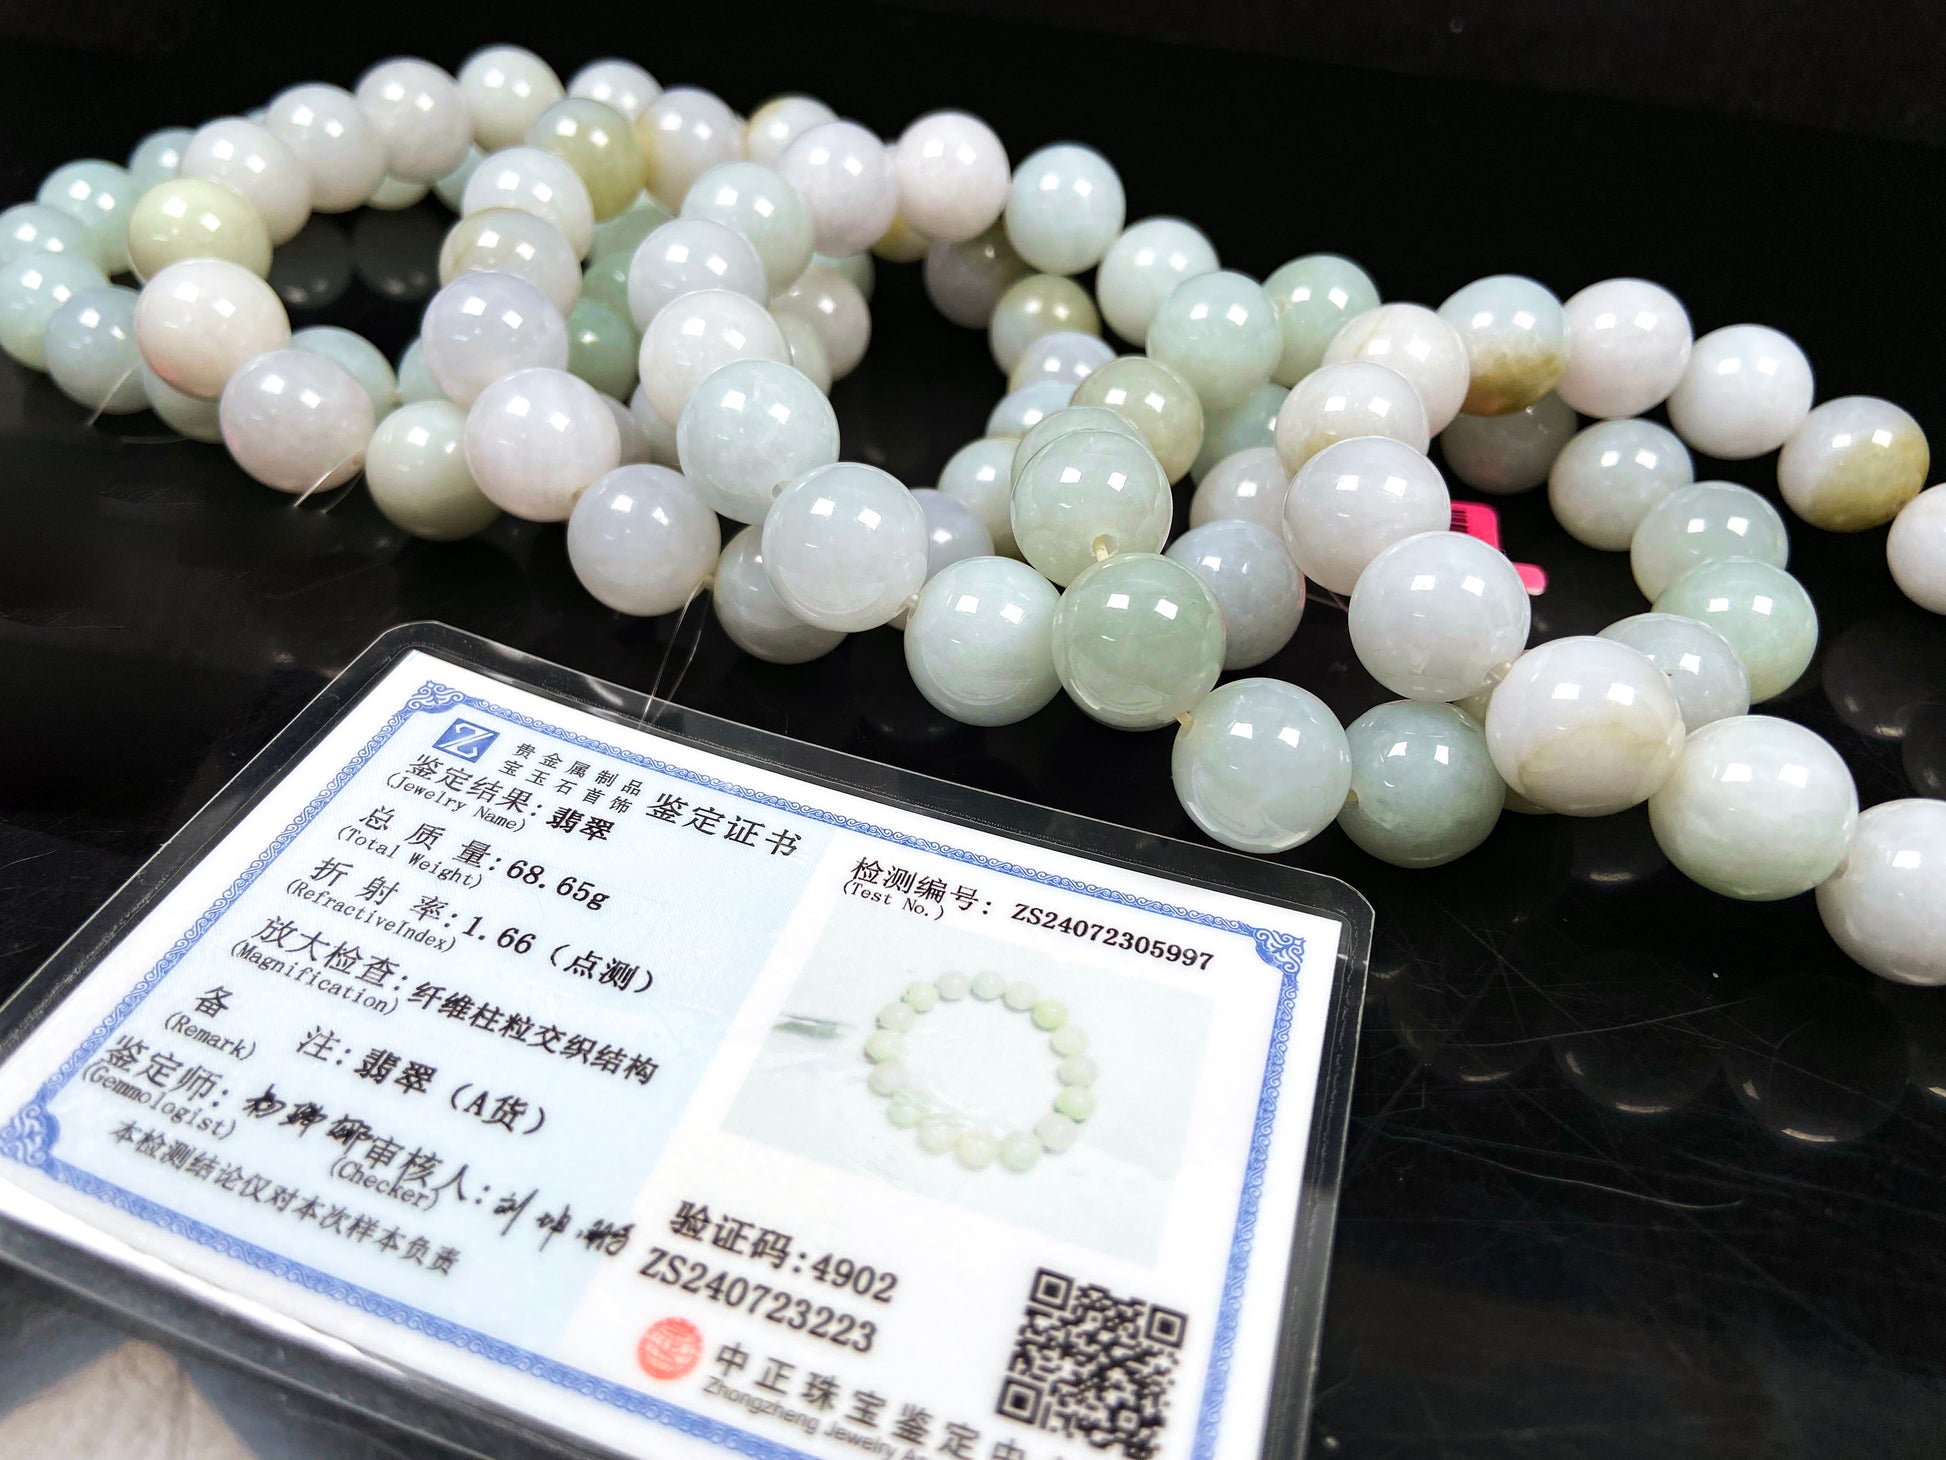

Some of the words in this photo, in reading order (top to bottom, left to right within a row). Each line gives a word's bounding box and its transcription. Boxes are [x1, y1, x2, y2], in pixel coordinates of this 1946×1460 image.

[386, 772, 467, 812] (Jewelry
[472, 805, 526, 833] Name)
[498, 759, 633, 814] 宝玉石首饰
[511, 742, 644, 797] 贵金属制品
[337, 825, 402, 860] (Total
[407, 852, 483, 890] Weight)
[646, 793, 802, 857] 鉴定证书
[286, 878, 457, 953] (RefractiveIndex)
[843, 880, 894, 907] (Test
[902, 898, 946, 921] No.)
[1011, 903, 1214, 971] ZS24072305997
[230, 939, 400, 1016] (Magnification)
[164, 1011, 257, 1061] (Remark)
[82, 1061, 238, 1141] (Gemmologist)
[109, 1120, 461, 1276] 本检测结论仅对本次样本负责
[330, 1155, 440, 1212] (Checker)
[639, 1247, 878, 1353] ZS240723223
[703, 1375, 820, 1435] Zhongzheng
[824, 1420, 898, 1458] Jewelry
[715, 1341, 1064, 1460] 中正珠宝鉴定中
